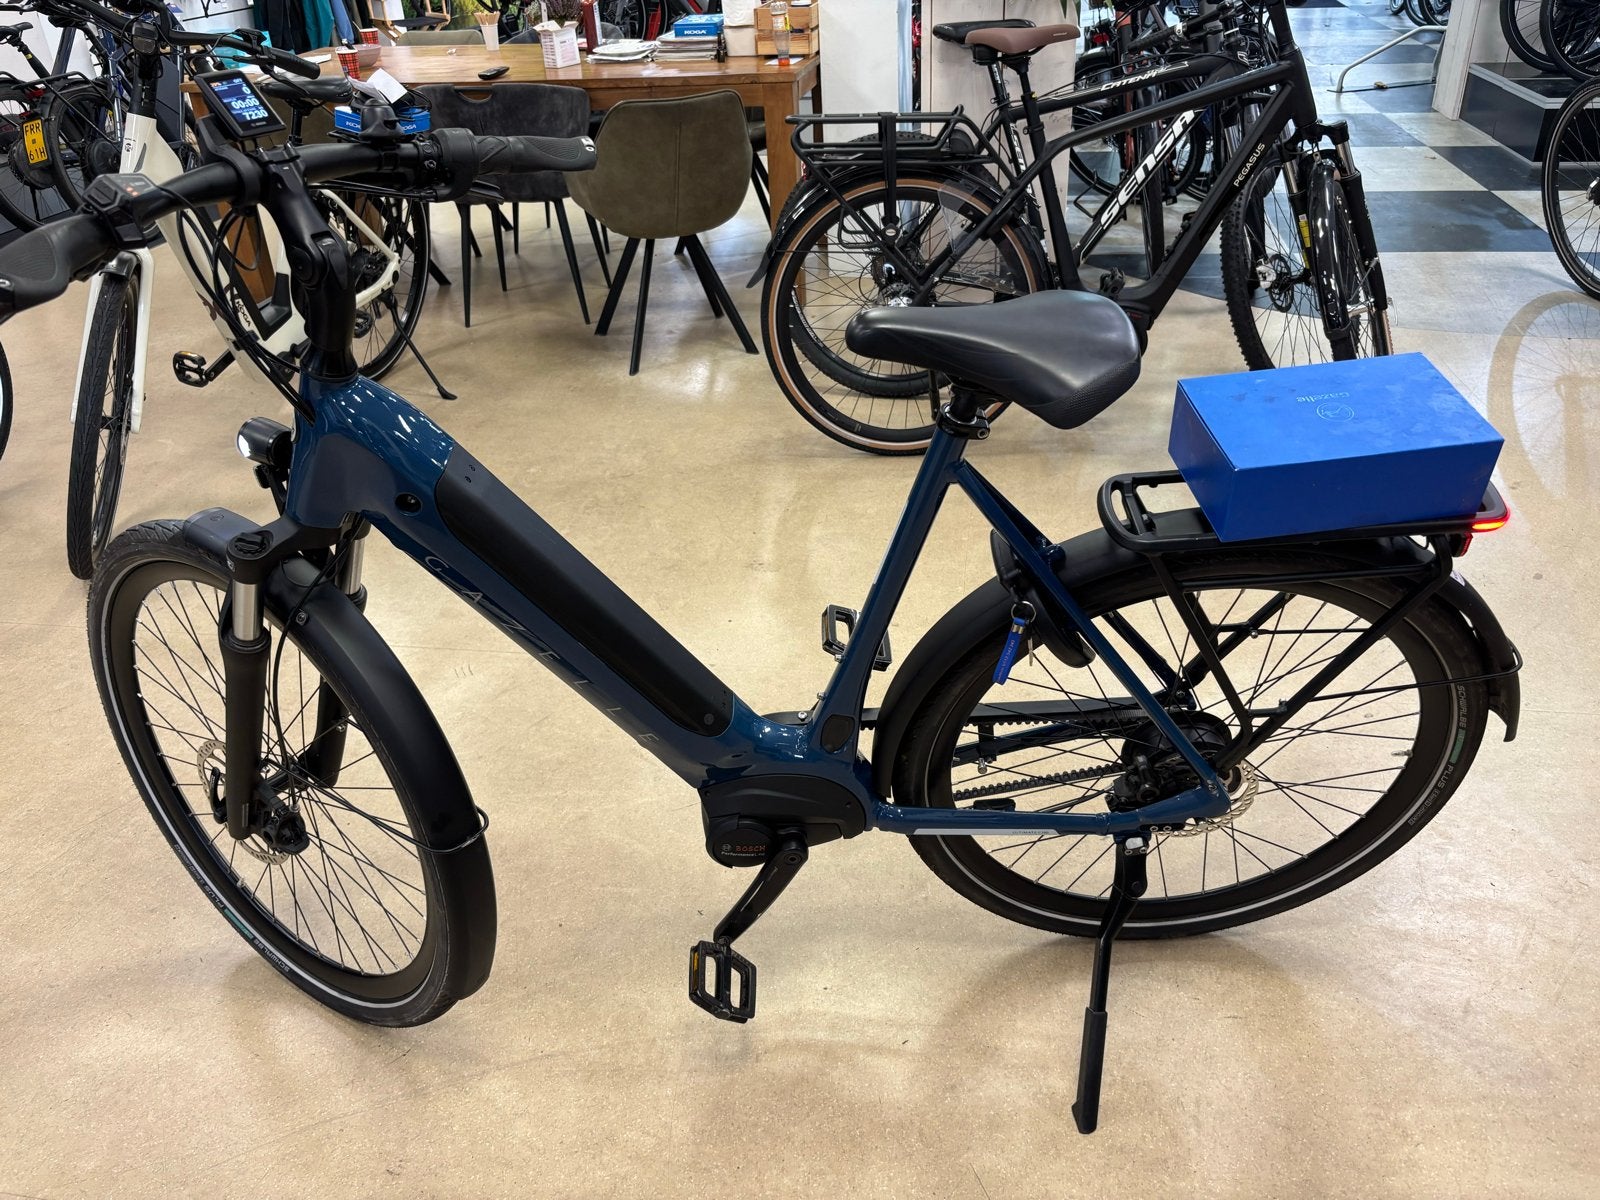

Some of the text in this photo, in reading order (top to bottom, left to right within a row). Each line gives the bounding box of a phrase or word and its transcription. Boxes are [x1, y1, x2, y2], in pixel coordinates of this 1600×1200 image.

[231, 98, 260, 109] 00:00
[242, 110, 269, 121] 7230
[1233, 142, 1265, 187] PEGASUS
[424, 555, 660, 743] GAZELLE
[1457, 685, 1468, 729] SCHWALBE
[1437, 764, 1455, 789] PLUS
[735, 845, 767, 853] BOSCH
[203, 885, 291, 974] SCHWALBE PLUS
